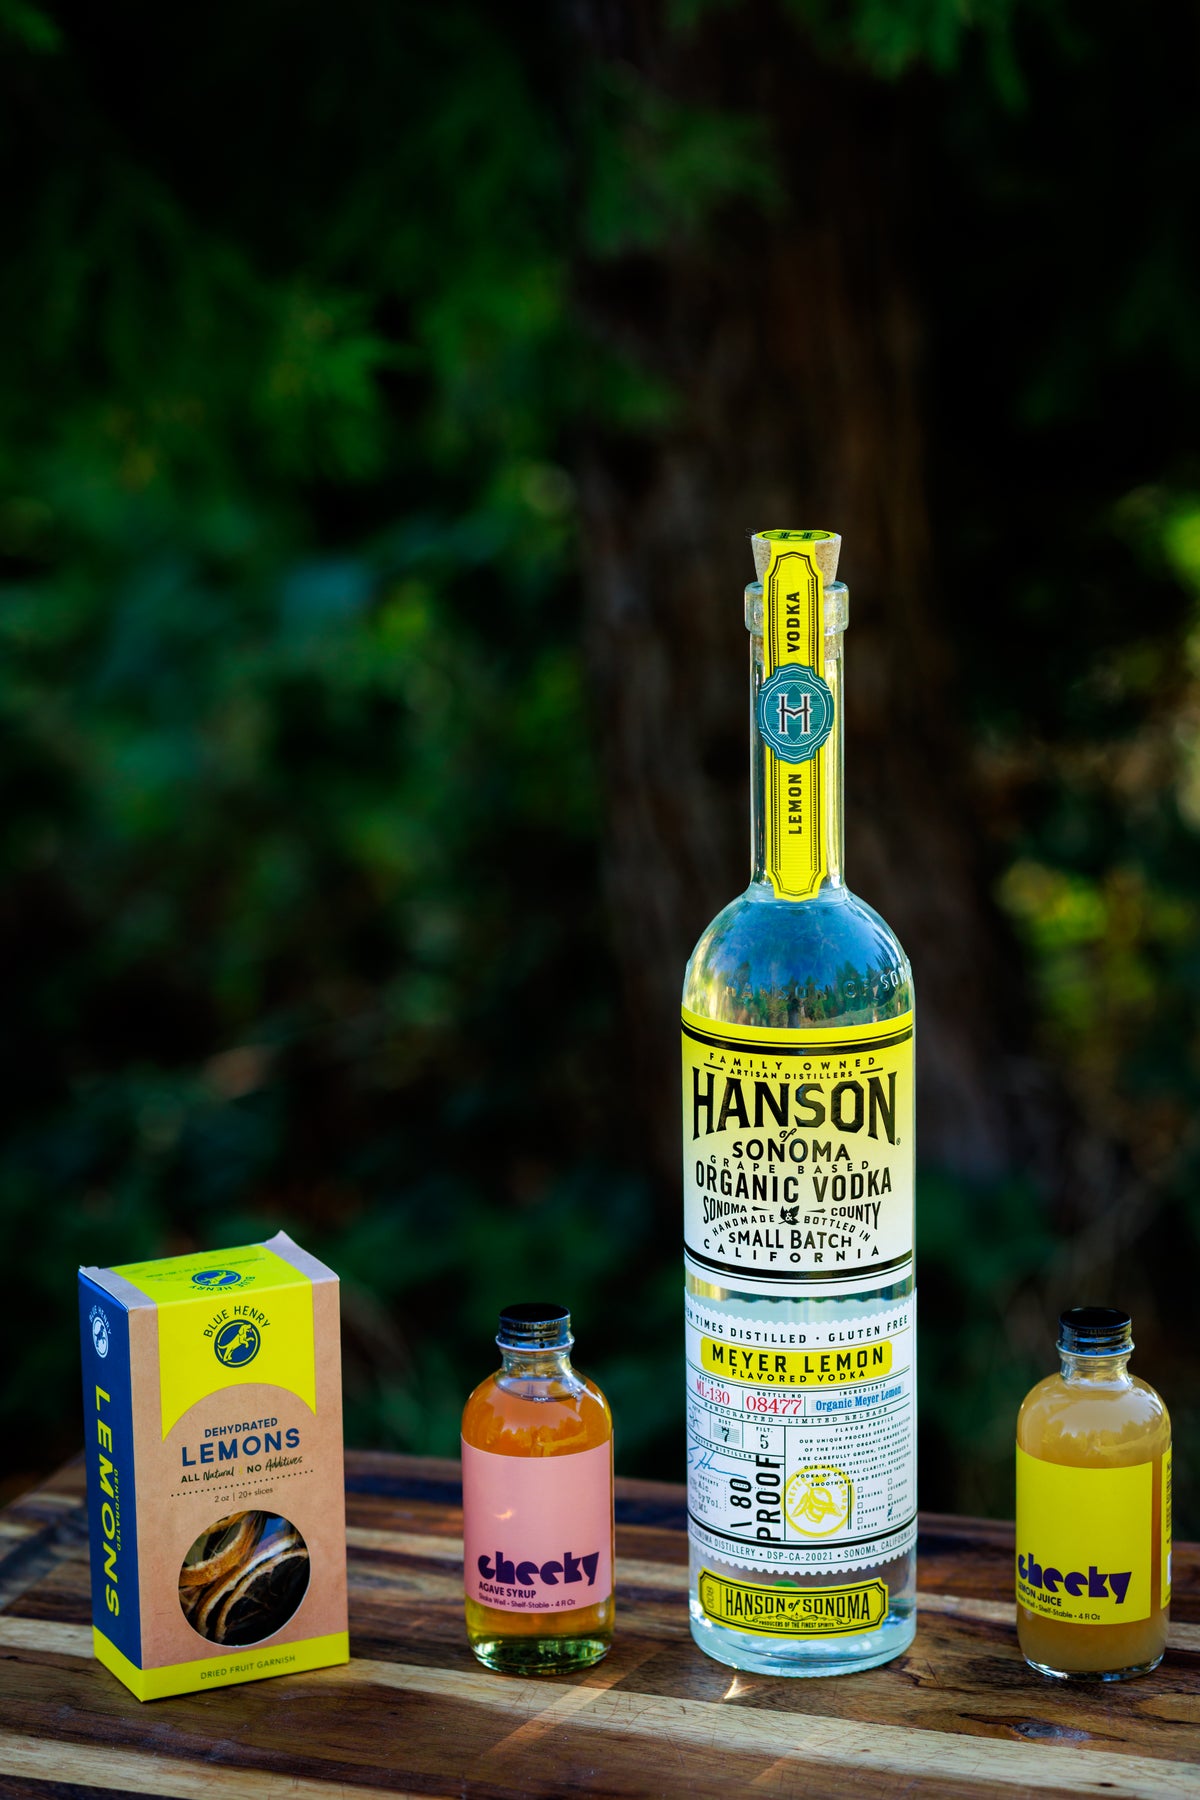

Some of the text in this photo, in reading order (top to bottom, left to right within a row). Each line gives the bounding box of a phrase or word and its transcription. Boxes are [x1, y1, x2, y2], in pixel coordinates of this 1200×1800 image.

[786, 591, 800, 653] VODKA
[779, 693, 810, 735] H
[788, 773, 802, 835] LEMON
[709, 1052, 876, 1071] FAMILY OWNED
[729, 1068, 853, 1080] ARTISAN DISTILLERS
[692, 1065, 898, 1146] HANSON
[779, 1127, 797, 1142] of
[732, 1138, 851, 1163] SONOMA
[710, 1154, 869, 1174] GRAPE BASED
[695, 1160, 892, 1203] ORGANIC VODKA
[703, 1195, 881, 1230] SONOMA COUNTY
[712, 1214, 775, 1236] HANDMADE
[804, 1215, 855, 1233] BOTTLED
[859, 1229, 871, 1241] IN
[703, 1238, 880, 1263] CALIFORNIA
[728, 1229, 852, 1250] SMALL BATCH
[203, 1305, 271, 1338] BLUE HENRY
[695, 1314, 724, 1334] TIMES
[730, 1327, 807, 1344] DISTILLED
[828, 1325, 881, 1343] GLUTEN
[886, 1314, 908, 1331] FREE
[712, 1343, 884, 1373] MEYER LEMON
[732, 1368, 866, 1383] FLAVORED VODKA
[816, 1385, 902, 1413] Organic Meyer Lemon
[839, 1383, 886, 1396] INGREDIENTS
[704, 1402, 774, 1423] HANDCRAFTED
[844, 1407, 888, 1421] RELEASE
[746, 1395, 802, 1415] 08477
[204, 1417, 278, 1438] DEHYDRATED
[721, 1426, 730, 1443] 7
[835, 1415, 894, 1433] FLAVOR PROFILE
[182, 1427, 300, 1467] LEMONS
[716, 1446, 752, 1459] DISTILLER
[759, 1434, 769, 1449] 5
[814, 1453, 851, 1461] CAREFULLY
[848, 1455, 878, 1466] DISTILLER
[181, 1456, 303, 1484] ALL Natural NO Additives
[833, 1469, 861, 1477] CRYSTAL
[95, 1384, 120, 1617] LEMONS
[214, 1495, 219, 1503] 2
[238, 1491, 252, 1499] 20+
[254, 1487, 274, 1496] slices
[729, 1478, 752, 1509] 80
[755, 1454, 781, 1542] PROOF
[113, 1468, 122, 1551] DEHYDRATED
[713, 1538, 755, 1557] DISTILLERY
[767, 1551, 833, 1561] DSP-CA-20021
[844, 1546, 878, 1559] SONOMA,
[477, 1551, 599, 1586] cheeky
[1018, 1552, 1132, 1604] cheeky
[479, 1581, 537, 1599] AGAVE SYRUP
[1037, 1594, 1062, 1607] JUICE
[511, 1600, 550, 1609] Shelf-Stable
[725, 1588, 870, 1620] HANSON of SONOMA
[1038, 1604, 1073, 1619] Shelf-Stable
[200, 1654, 296, 1680] DRIED FRUIT GARNISH
